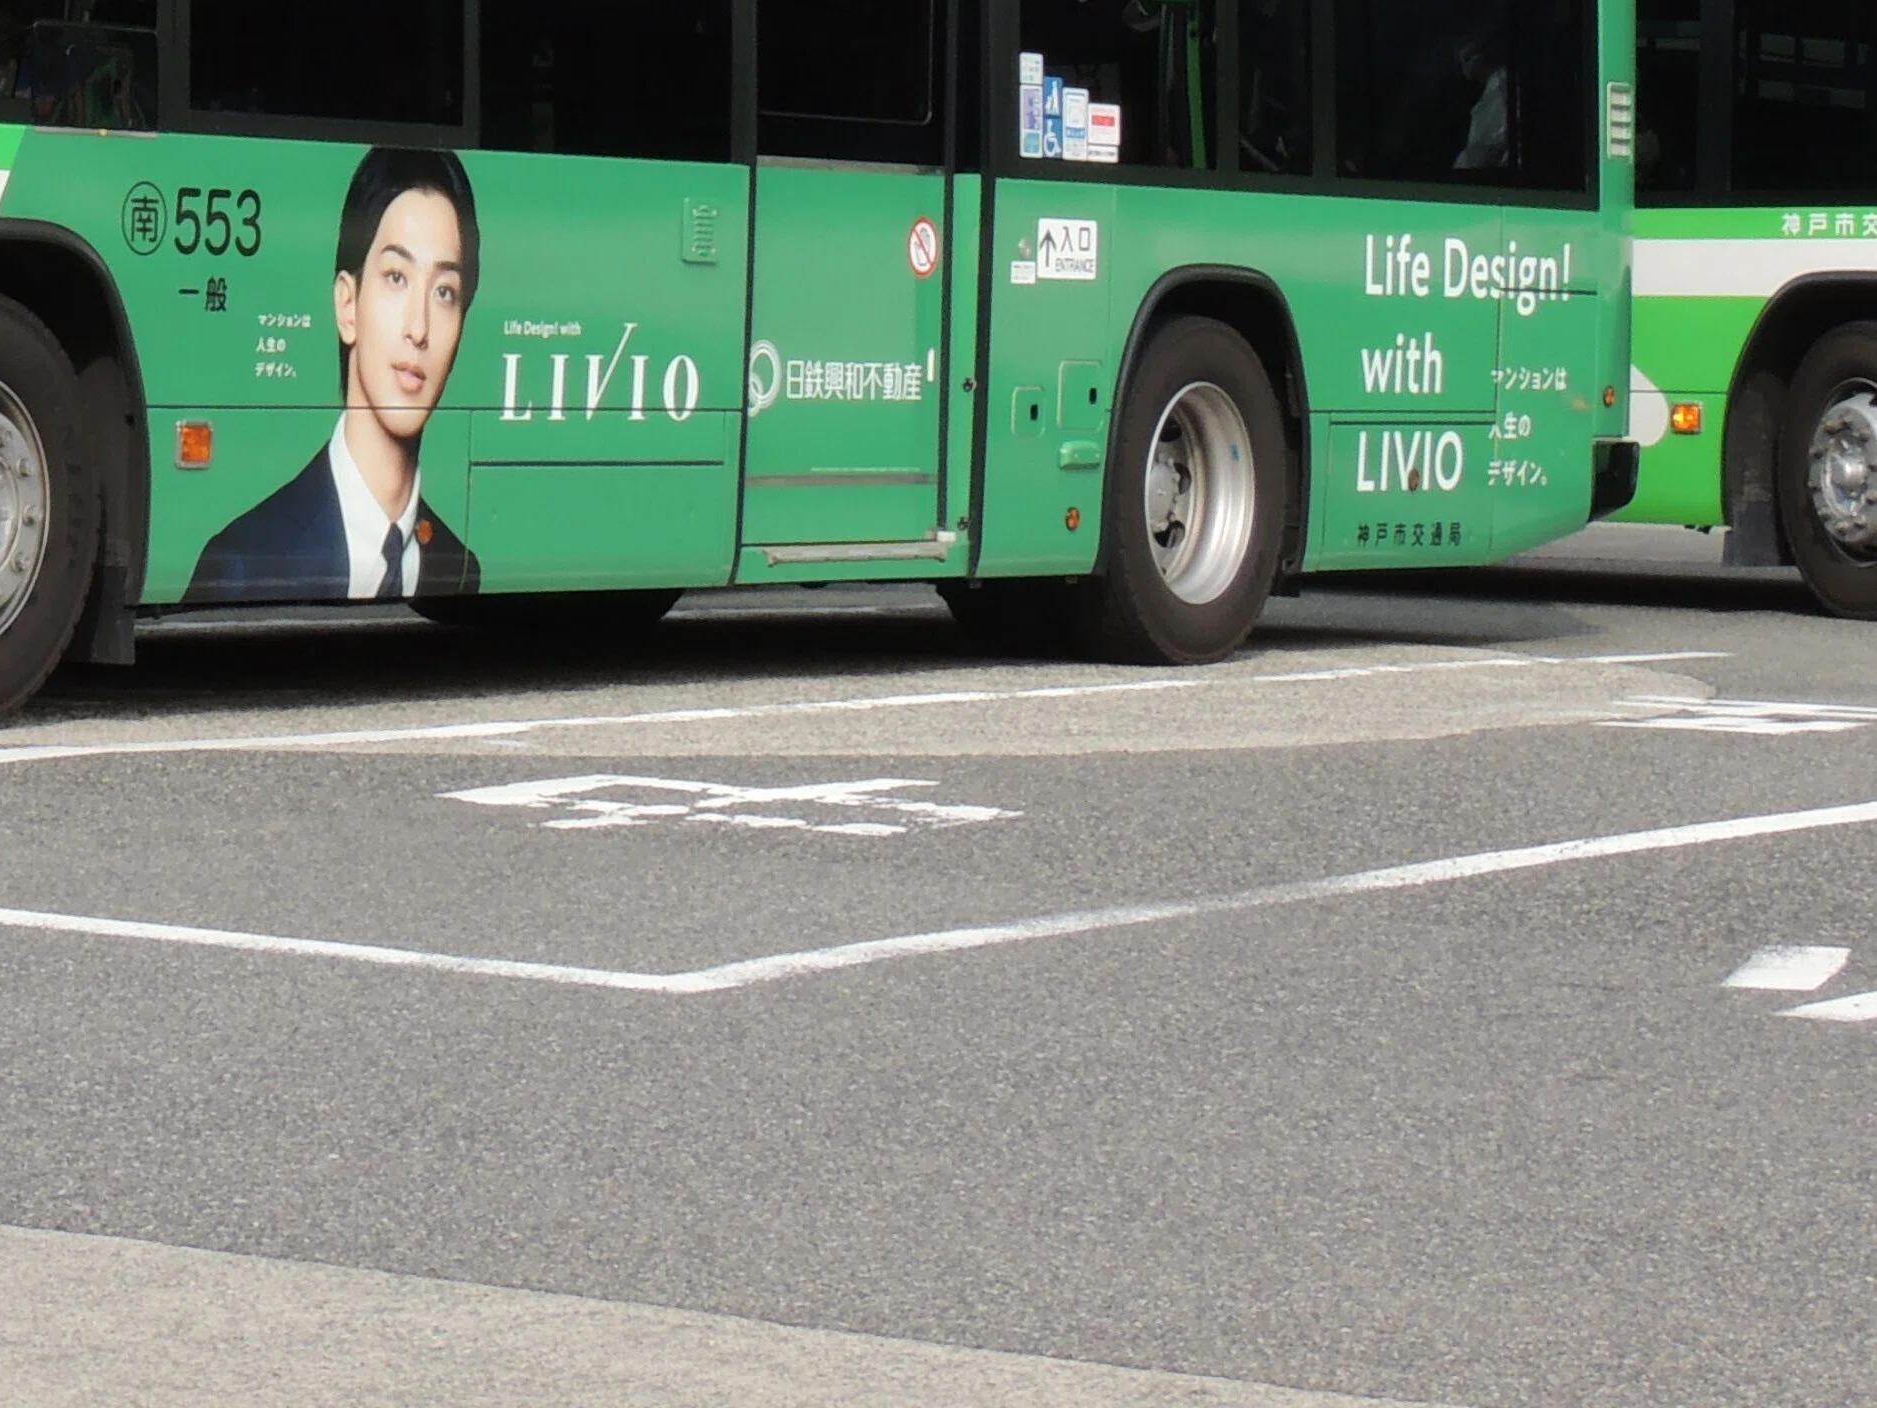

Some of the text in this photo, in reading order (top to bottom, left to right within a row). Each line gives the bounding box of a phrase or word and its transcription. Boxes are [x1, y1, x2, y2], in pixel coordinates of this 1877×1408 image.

[173, 187, 263, 257] 553
[1060, 225, 1091, 253] 入口
[1054, 257, 1095, 274] ENTRANCE
[1365, 233, 1572, 317] Life Design!
[178, 276, 228, 313] 一般
[503, 319, 523, 336] Life
[559, 321, 582, 336] with
[499, 322, 700, 422] LIVIO
[785, 359, 924, 401] 日鉄興和不動産
[1361, 332, 1444, 395] with
[1490, 367, 1568, 392] マンションは
[1488, 412, 1533, 440] 人生の
[1356, 430, 1465, 493] LIVIO
[1357, 522, 1463, 548] 神戸市交通局
